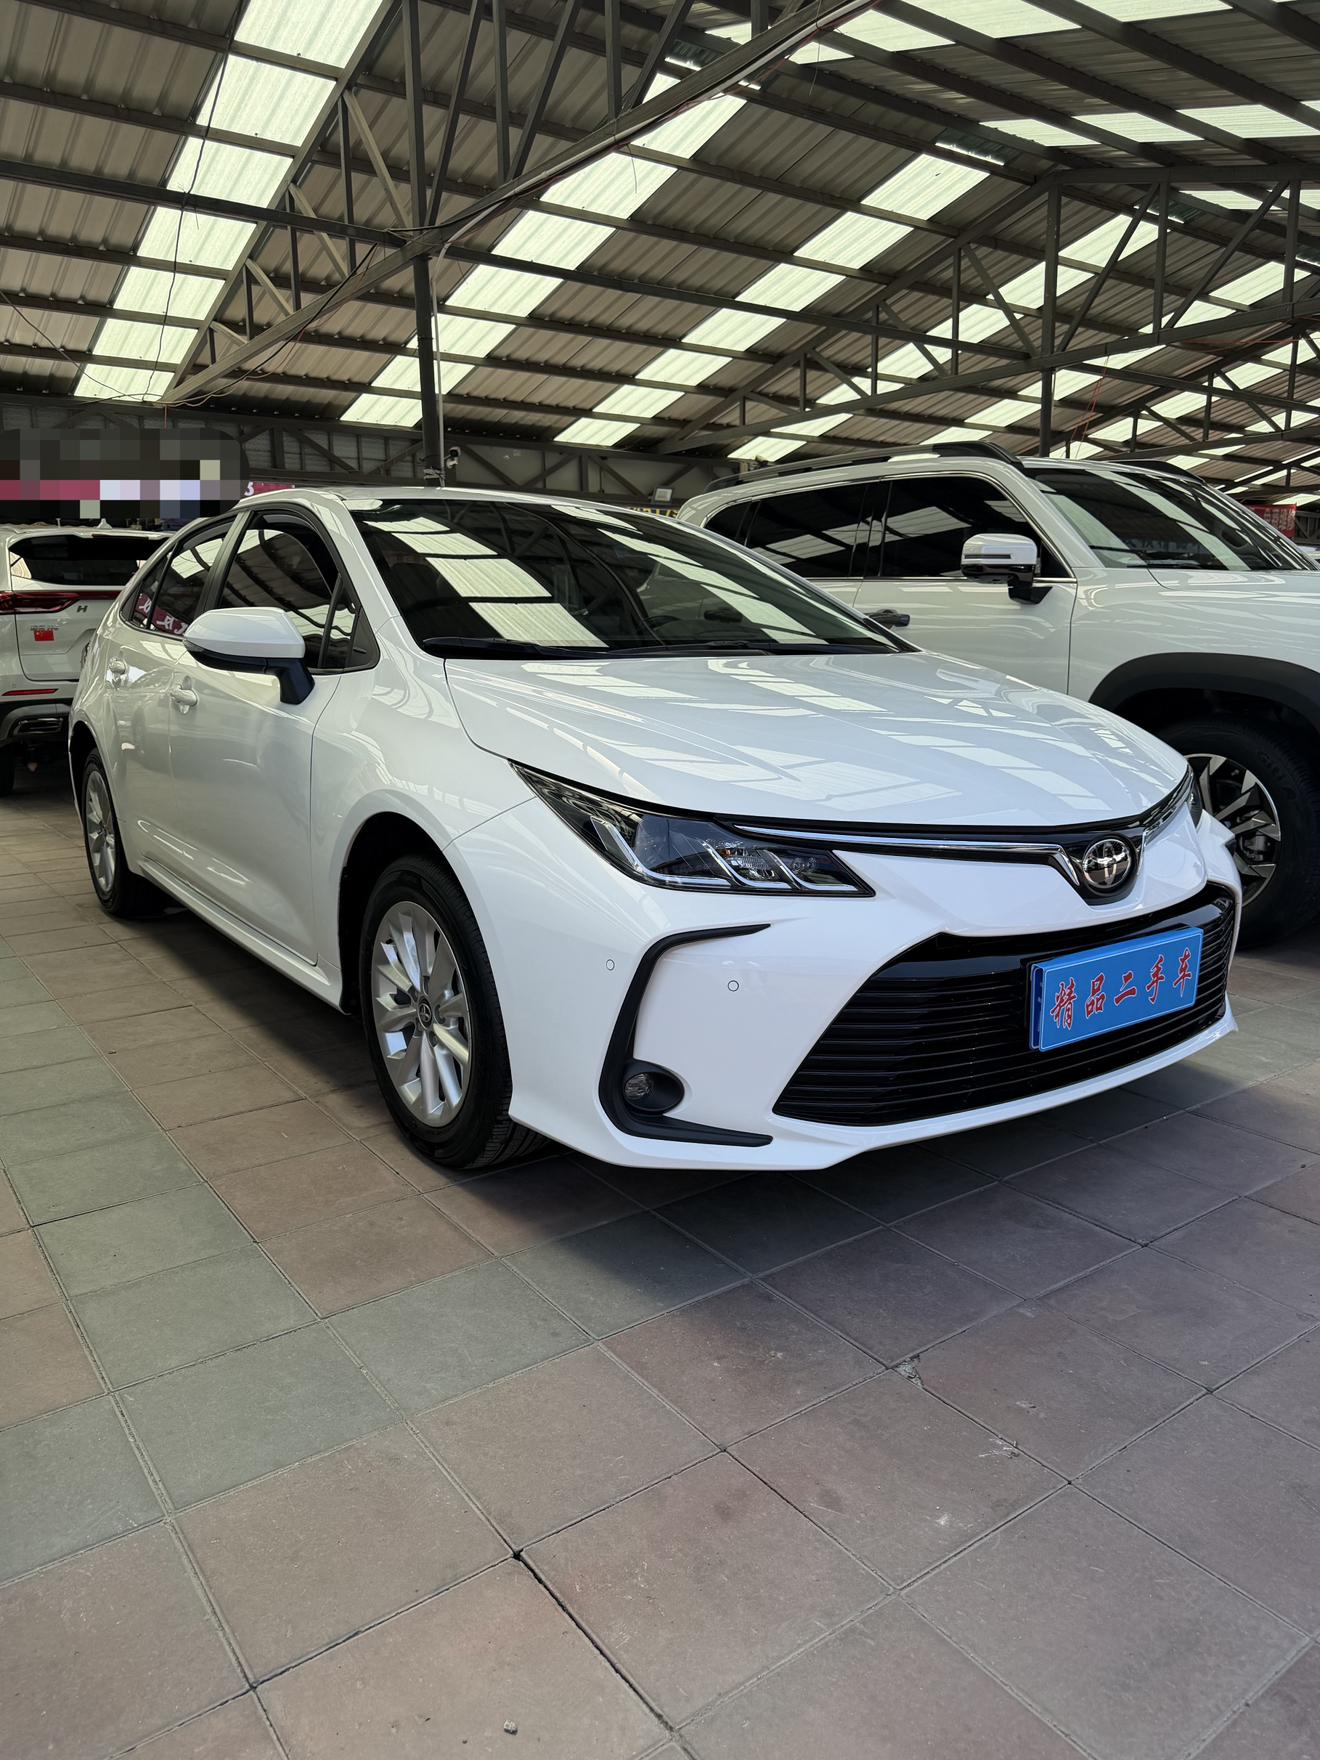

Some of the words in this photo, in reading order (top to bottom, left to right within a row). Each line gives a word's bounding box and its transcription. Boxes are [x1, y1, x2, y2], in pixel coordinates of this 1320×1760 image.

[77, 605, 88, 613] H
[1051, 948, 1192, 1030] 精品二手车
